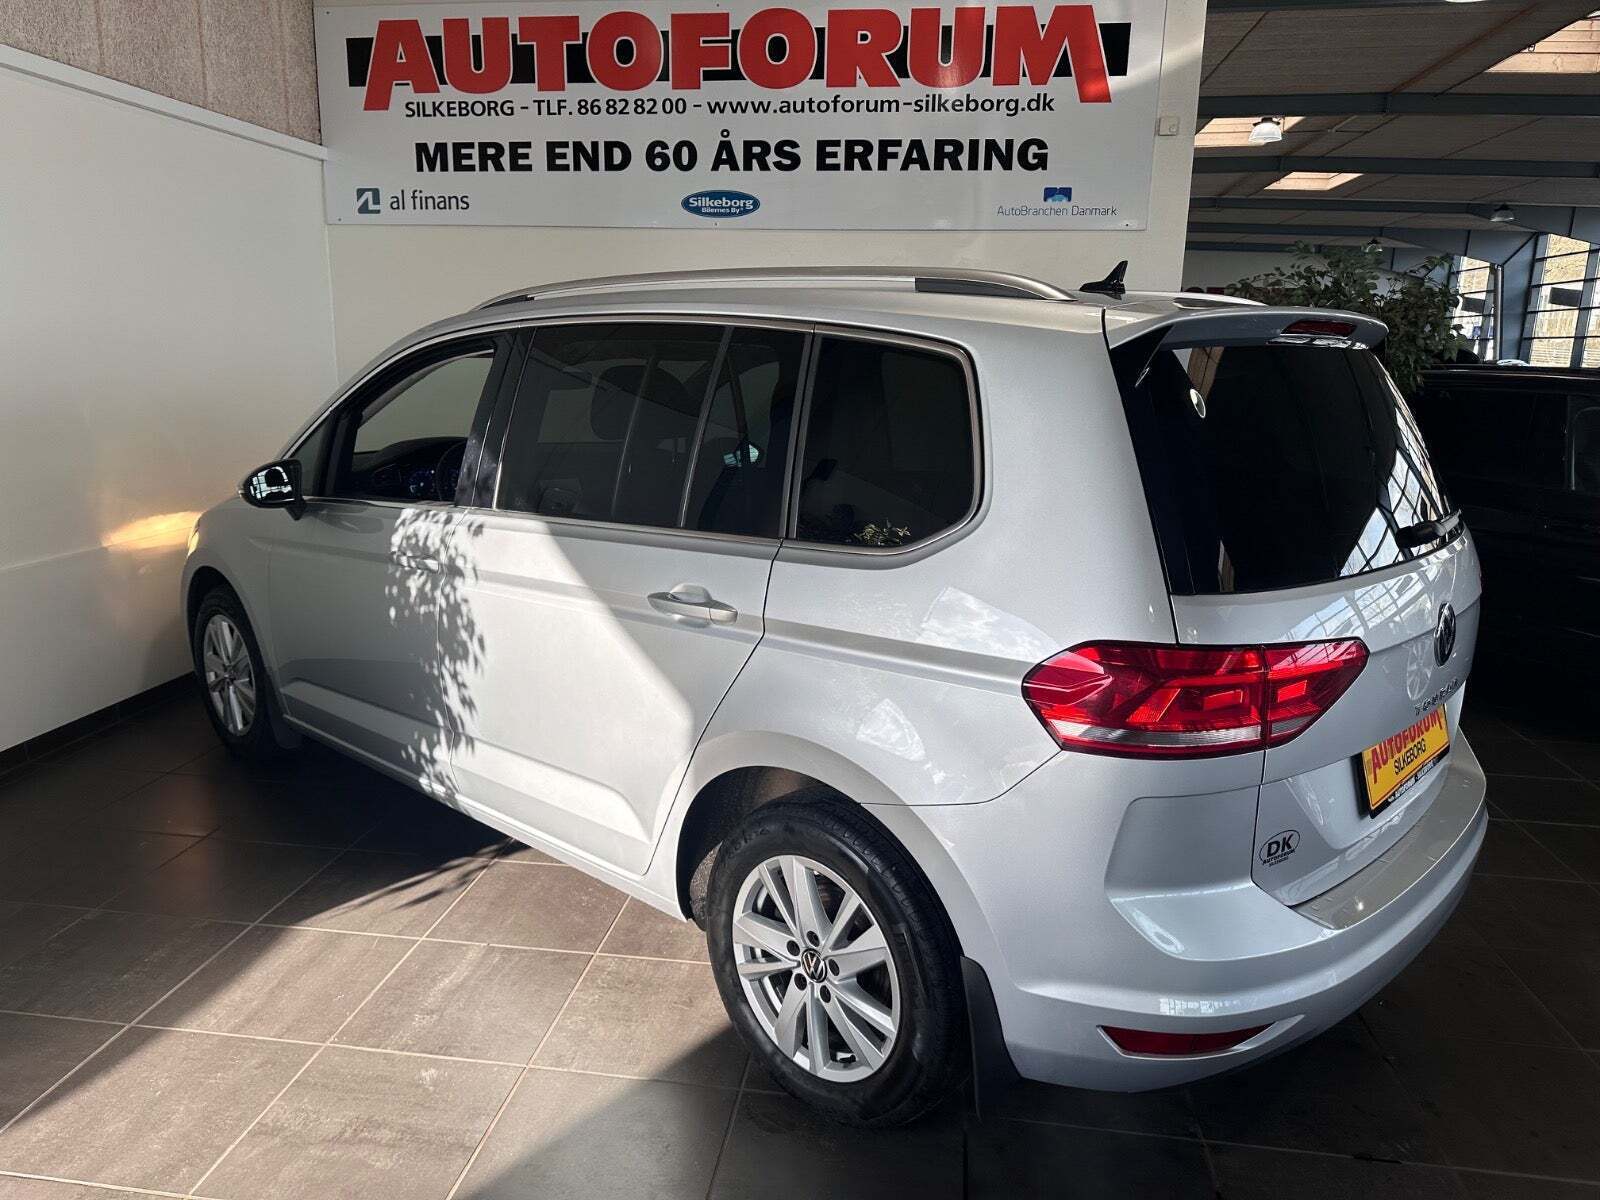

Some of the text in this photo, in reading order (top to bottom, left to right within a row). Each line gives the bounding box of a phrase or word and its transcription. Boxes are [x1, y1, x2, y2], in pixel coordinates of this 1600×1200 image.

[363, 4, 1112, 111] AUTOFORUM
[405, 100, 515, 118] SILKEBORG
[533, 99, 573, 116] TLF.
[707, 93, 1055, 117] www.autoforum-silkeborg.dk
[415, 129, 1049, 172] MERE END 60 ÅRS ERFARING
[390, 189, 470, 210] al finans
[688, 196, 754, 210] Silkeborg
[996, 205, 1118, 216] AutoBranchen Danmark
[1371, 710, 1443, 784] AUTOFORUM
[1393, 738, 1427, 776] SILKEBORG
[1267, 833, 1294, 858] DK
